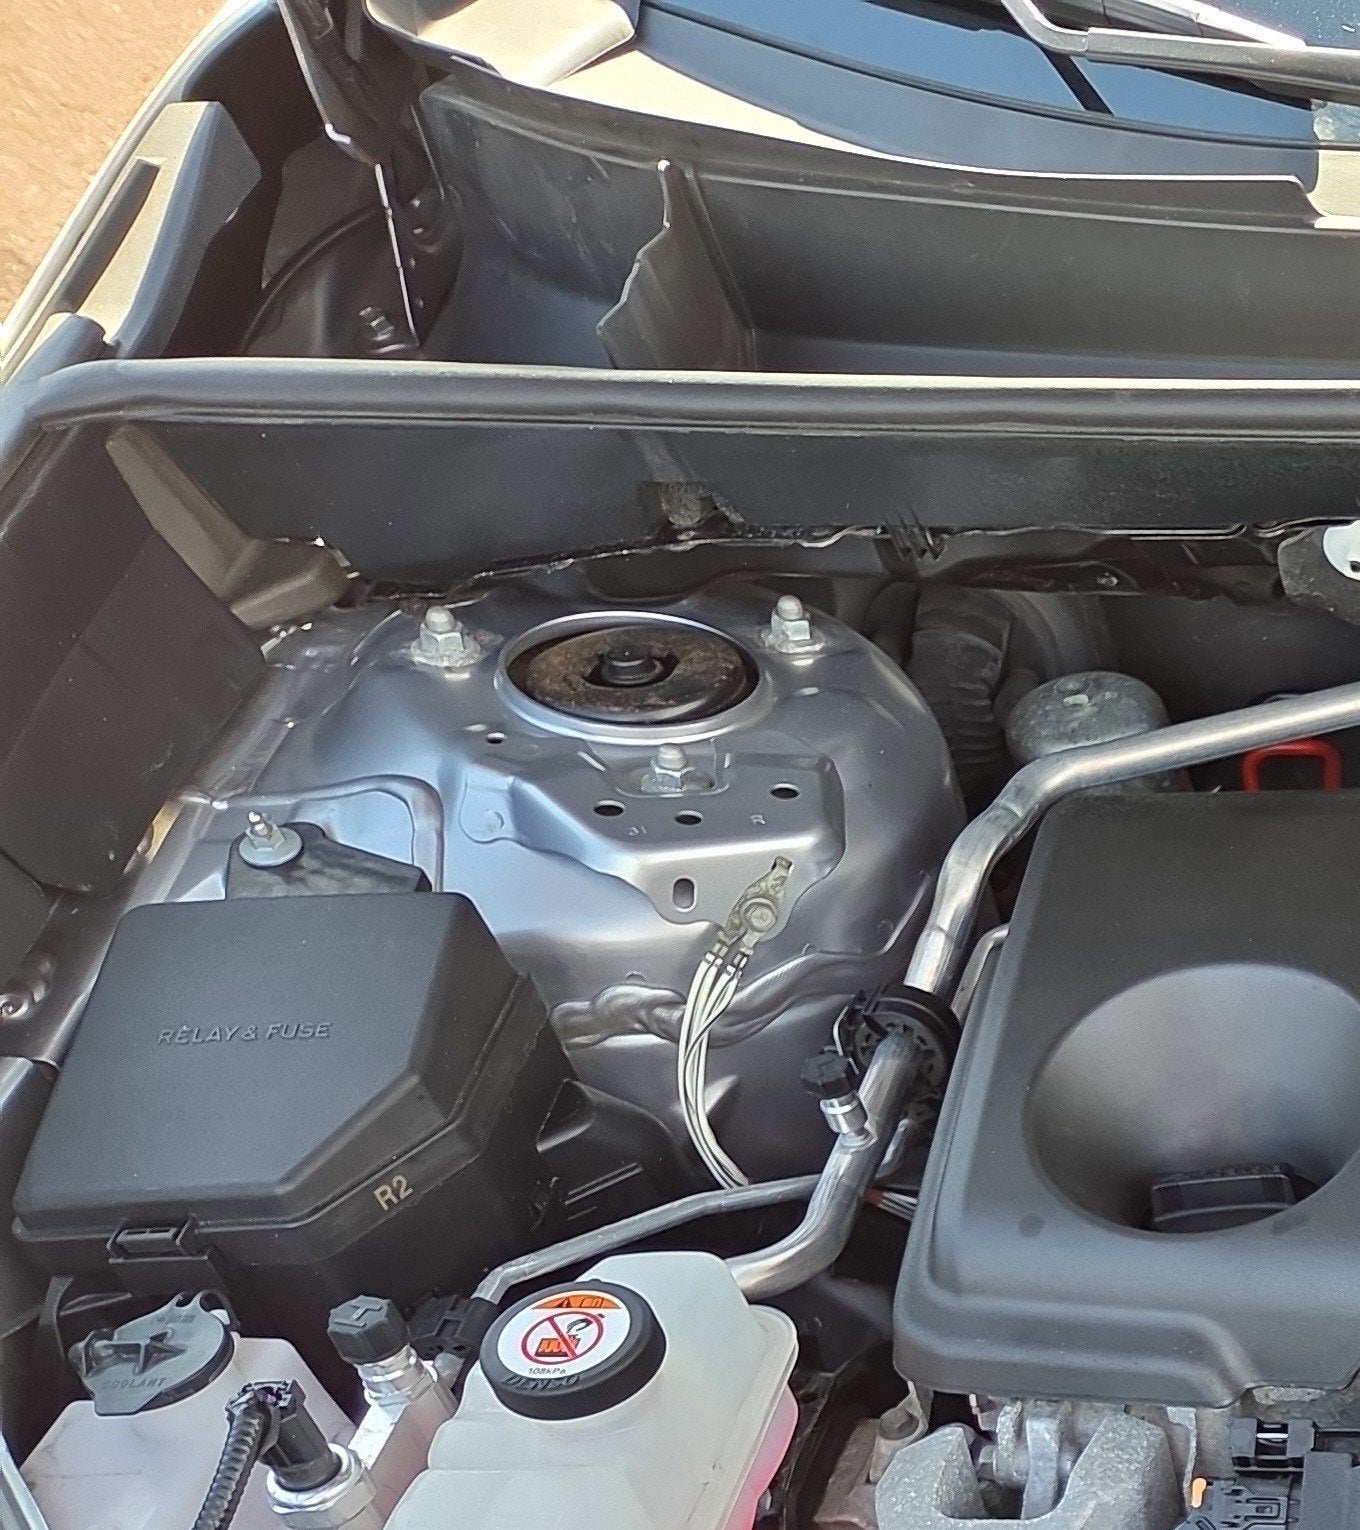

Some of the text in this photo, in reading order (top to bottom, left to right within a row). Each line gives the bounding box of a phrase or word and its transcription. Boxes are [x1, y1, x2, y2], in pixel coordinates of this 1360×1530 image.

[158, 1021, 332, 1045] RELAY & FUSE
[374, 1175, 414, 1211] R2
[102, 1378, 168, 1390] COOLANT
